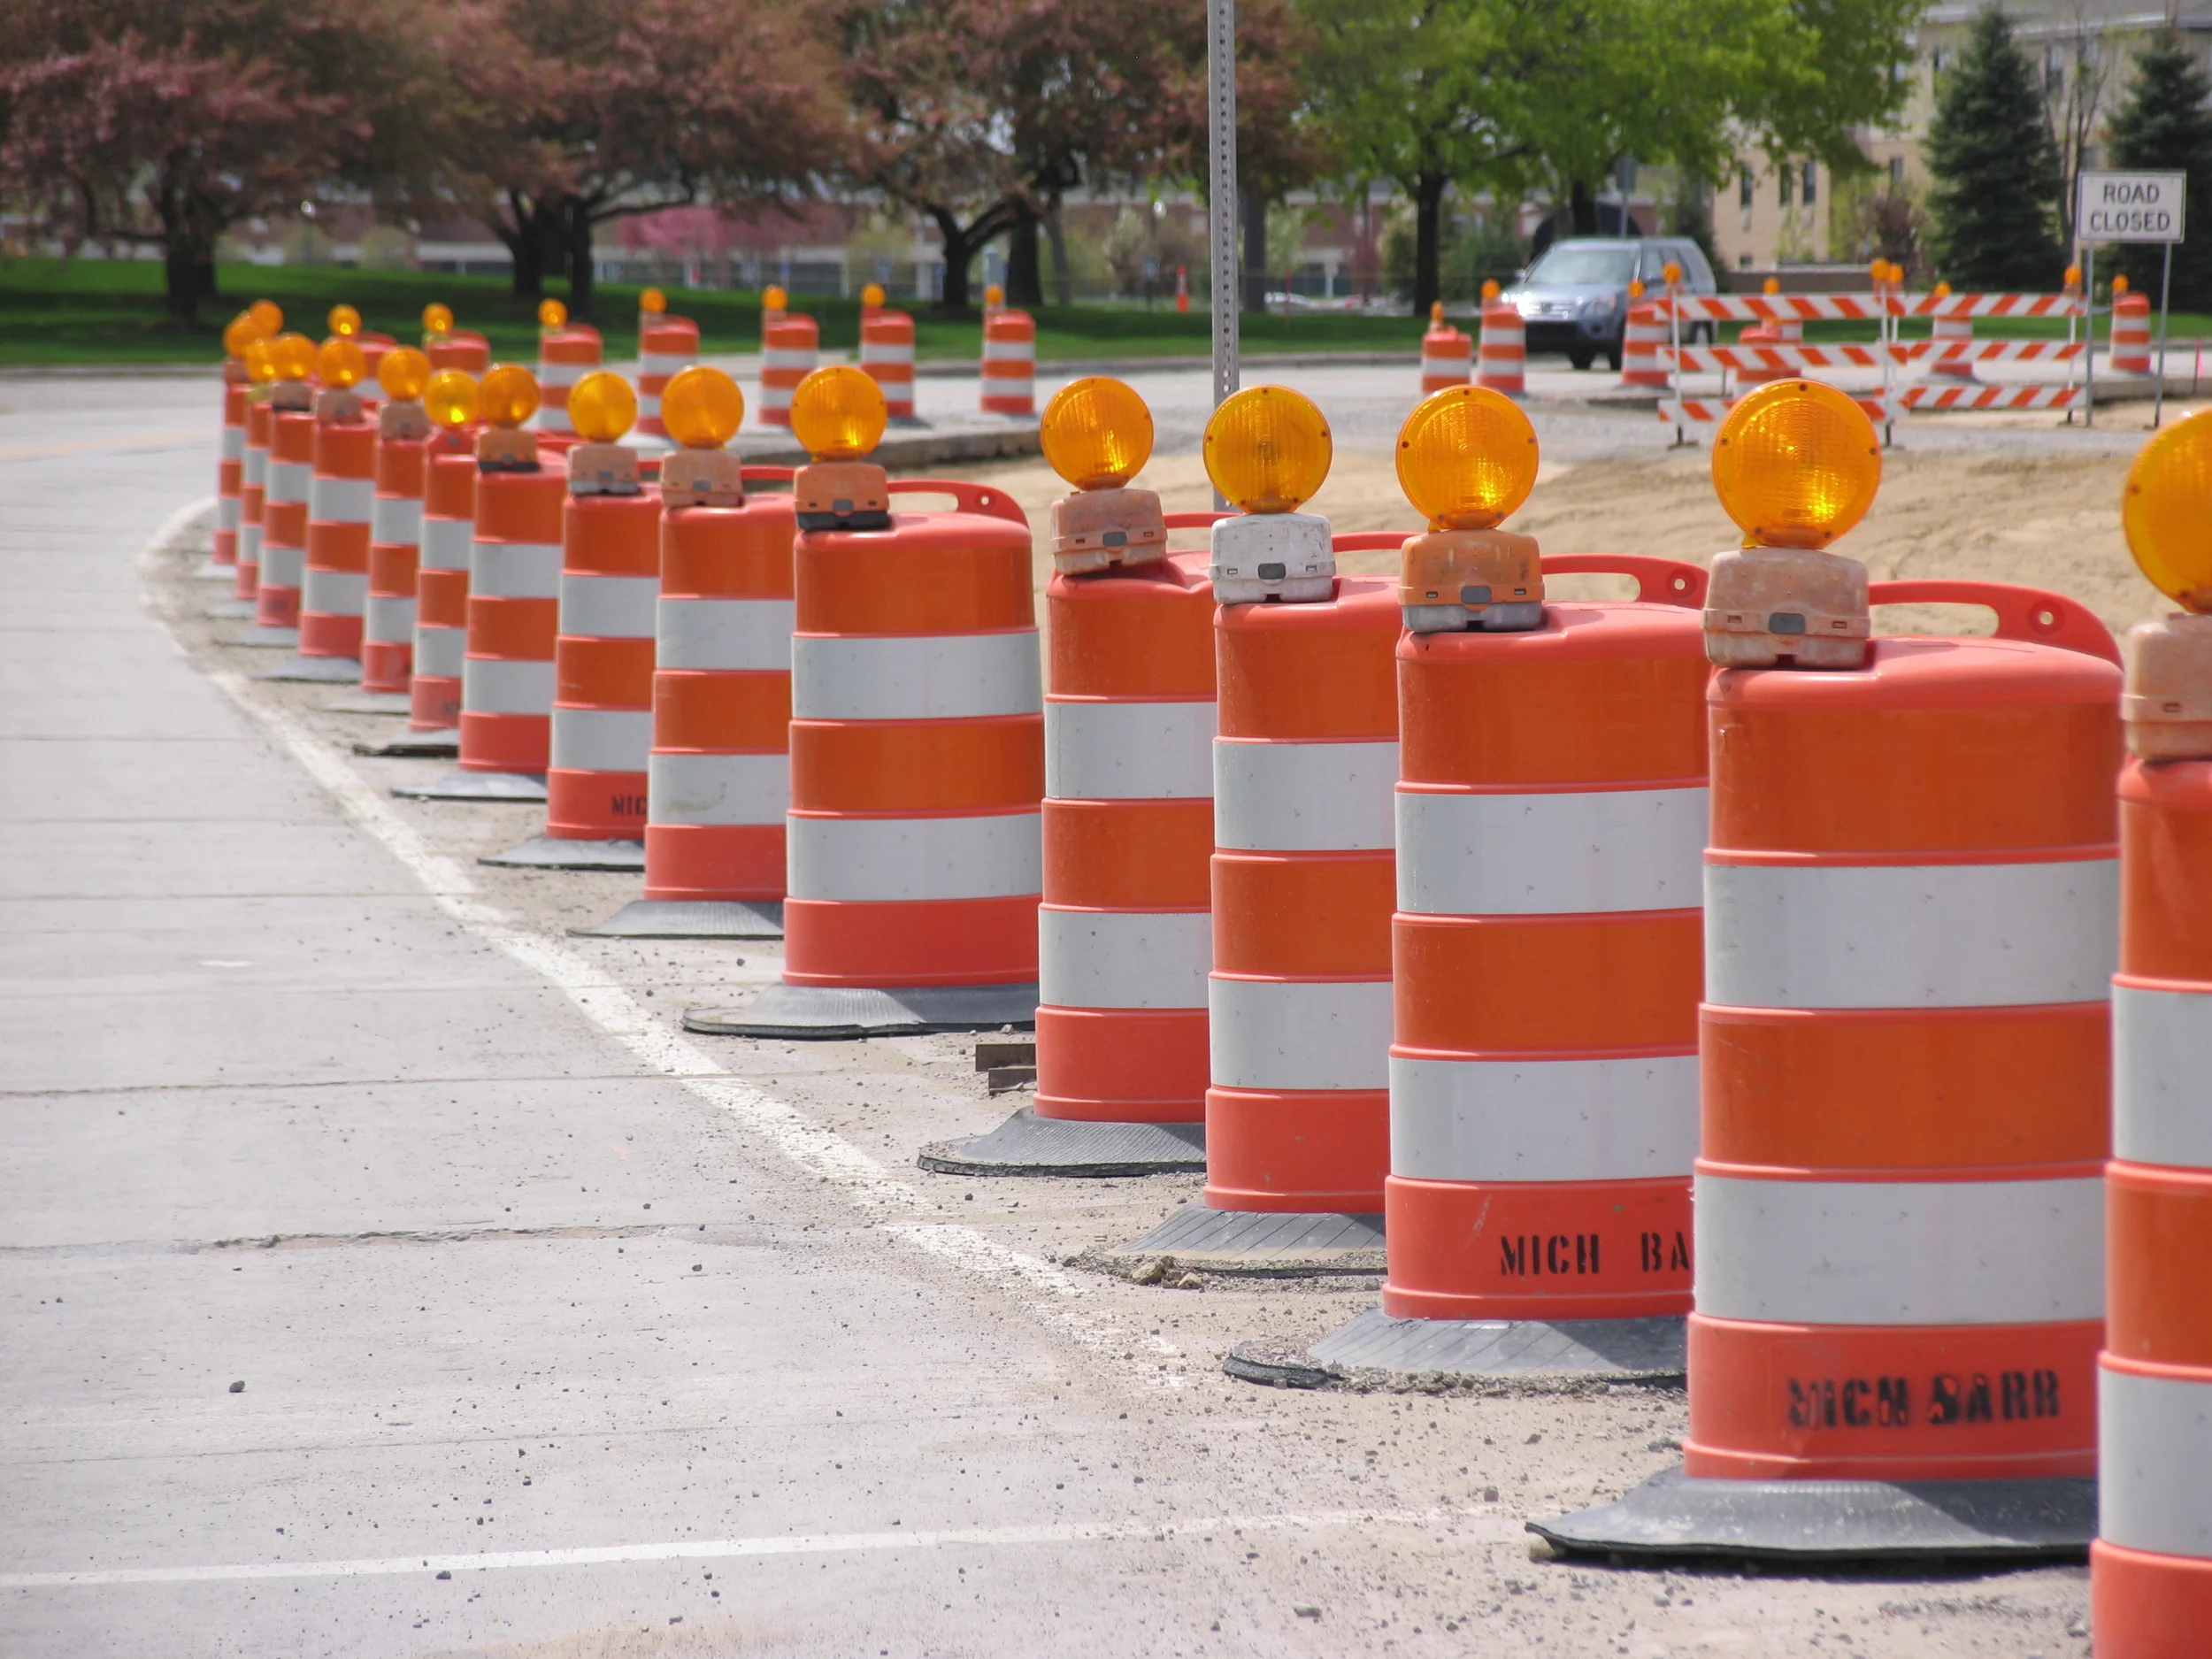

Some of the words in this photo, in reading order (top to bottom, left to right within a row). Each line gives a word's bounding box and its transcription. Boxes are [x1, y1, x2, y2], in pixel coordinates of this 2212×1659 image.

[2102, 181, 2160, 204] ROAD
[2090, 210, 2171, 232] CLOSED
[1500, 1233, 1600, 1276] MICH
